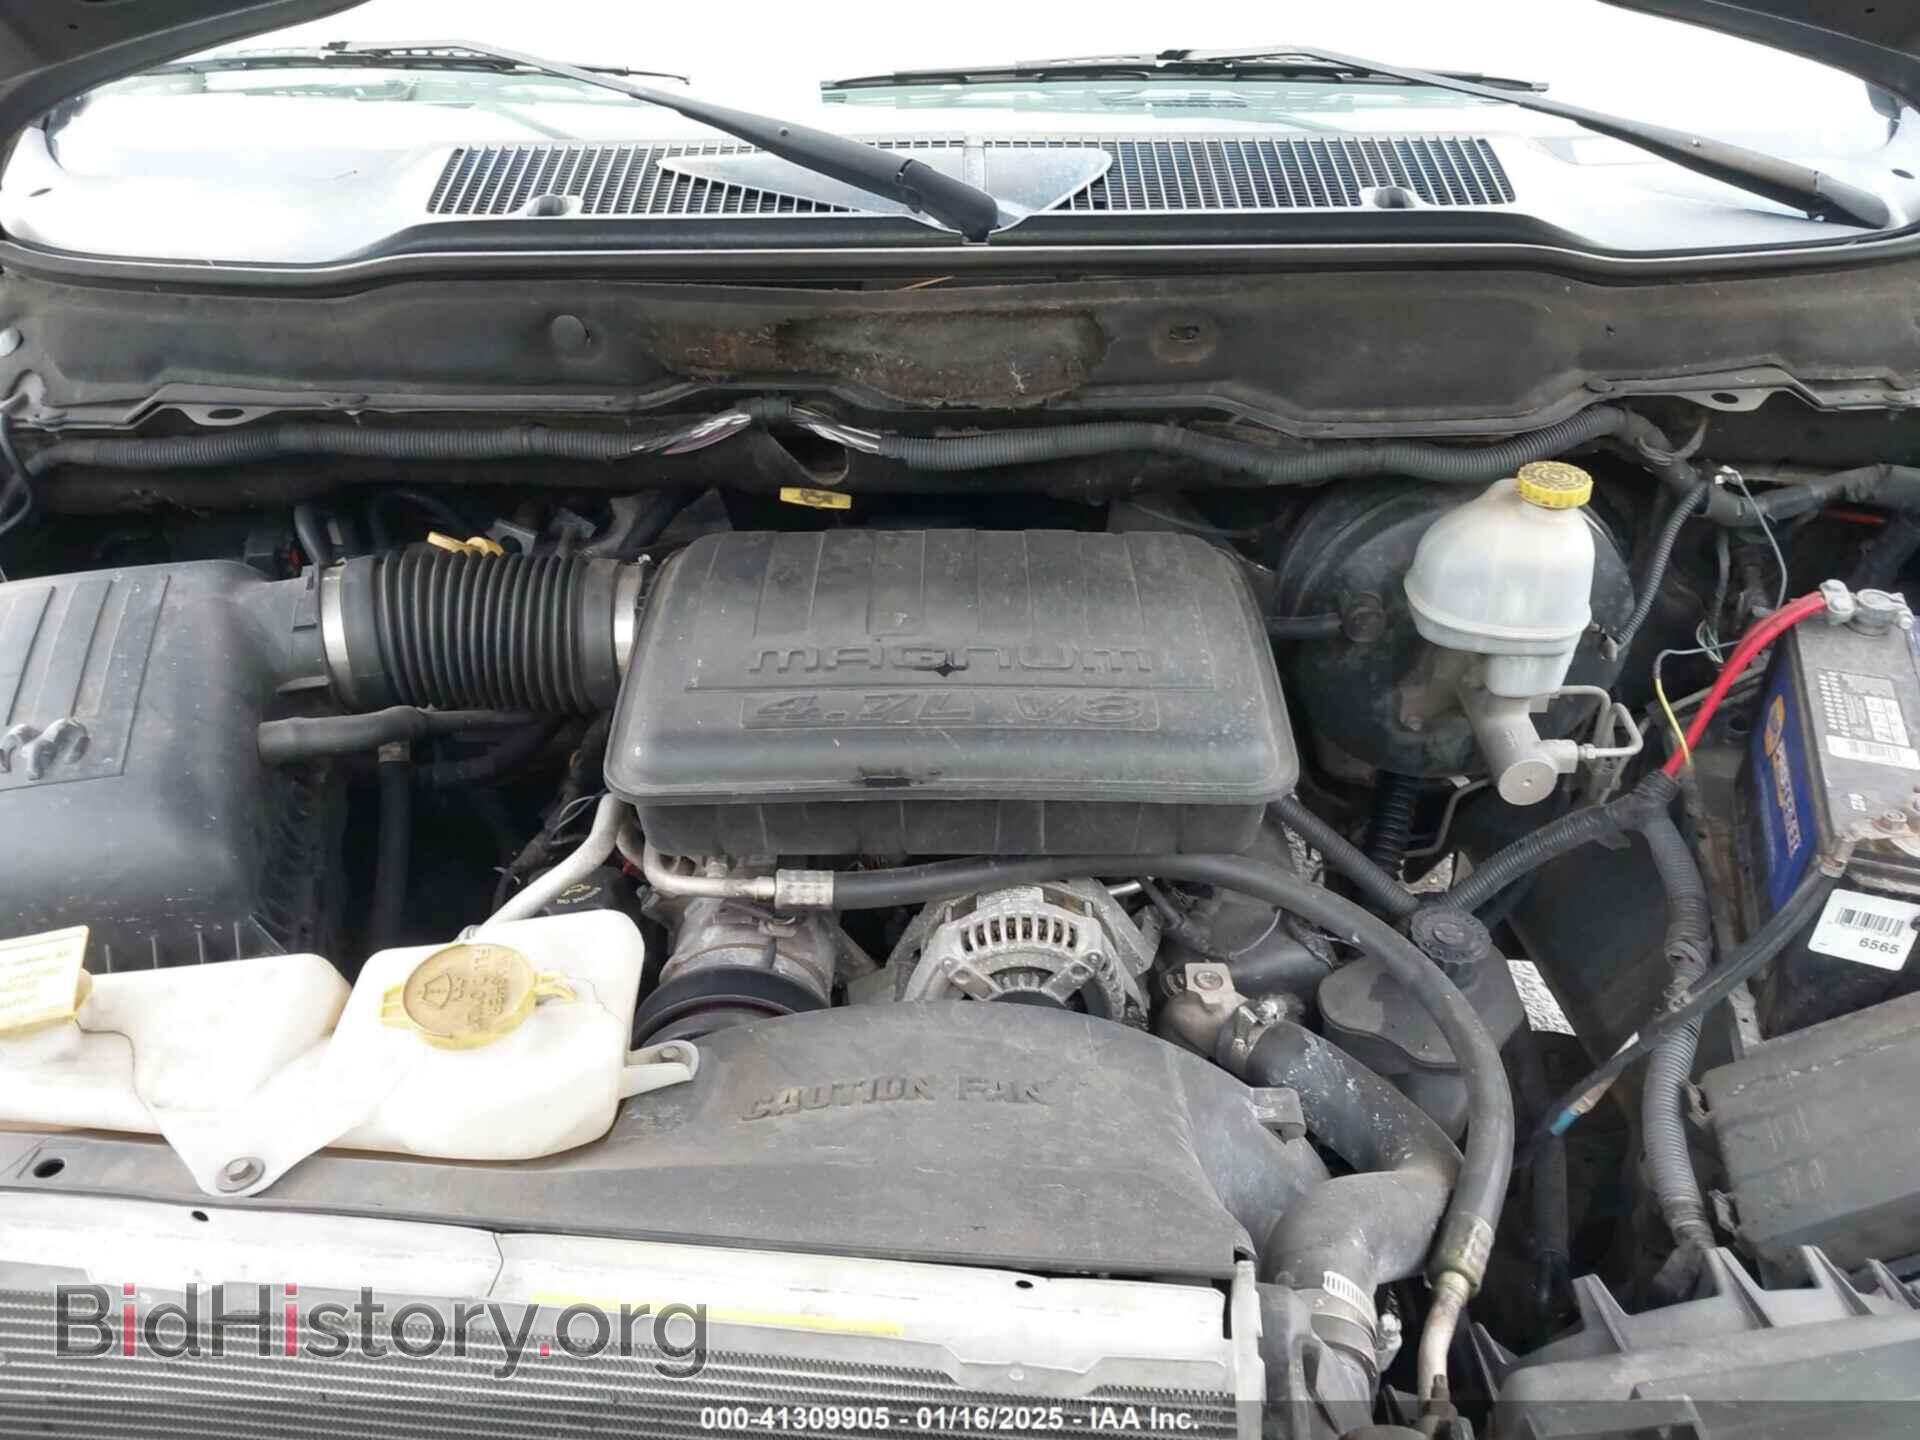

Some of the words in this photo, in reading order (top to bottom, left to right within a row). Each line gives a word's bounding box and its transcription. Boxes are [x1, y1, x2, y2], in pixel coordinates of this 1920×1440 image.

[757, 694, 972, 722] 4.7L
[1015, 694, 1144, 723] V8
[1859, 937, 1900, 955] 6565
[741, 1073, 937, 1121] CAUTION
